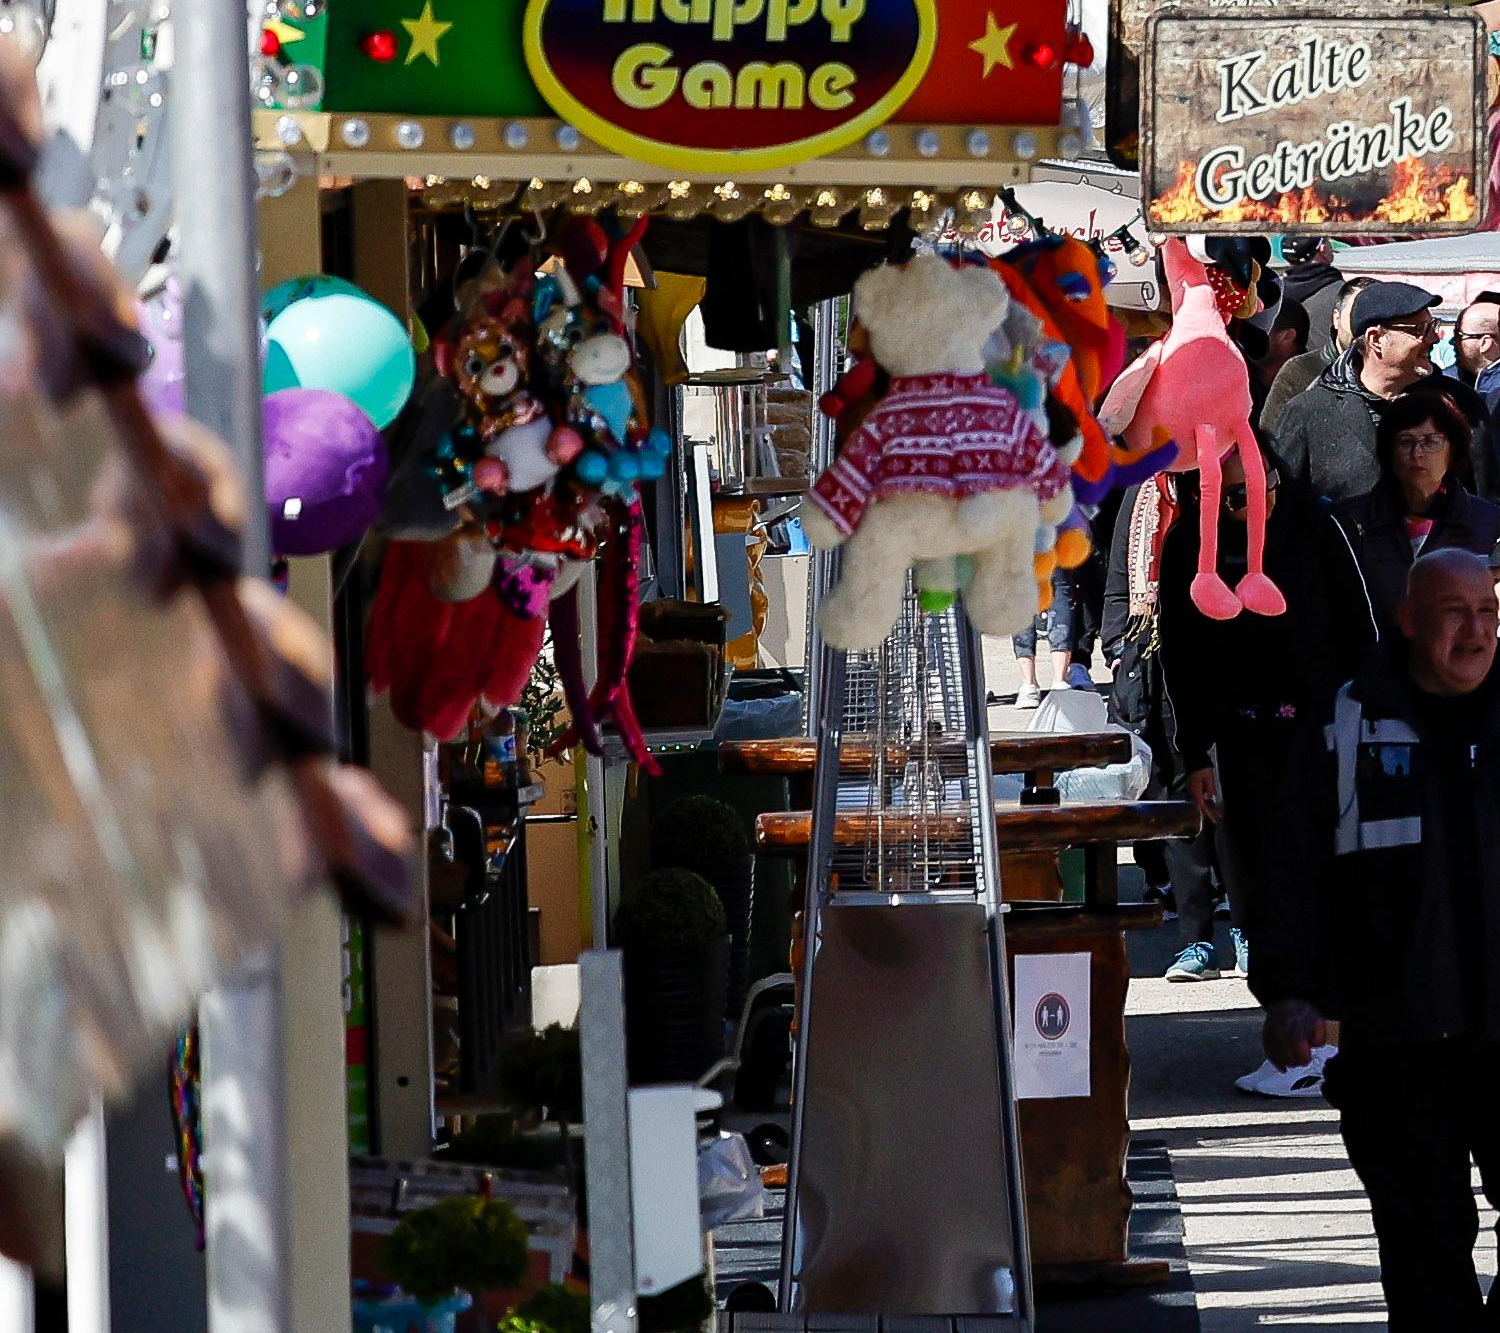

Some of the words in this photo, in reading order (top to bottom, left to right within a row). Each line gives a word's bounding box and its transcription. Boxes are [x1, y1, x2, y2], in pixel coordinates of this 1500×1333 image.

[611, 44, 857, 111] Game
[1214, 42, 1371, 123] Kalte
[1195, 102, 1455, 211] Getränke
